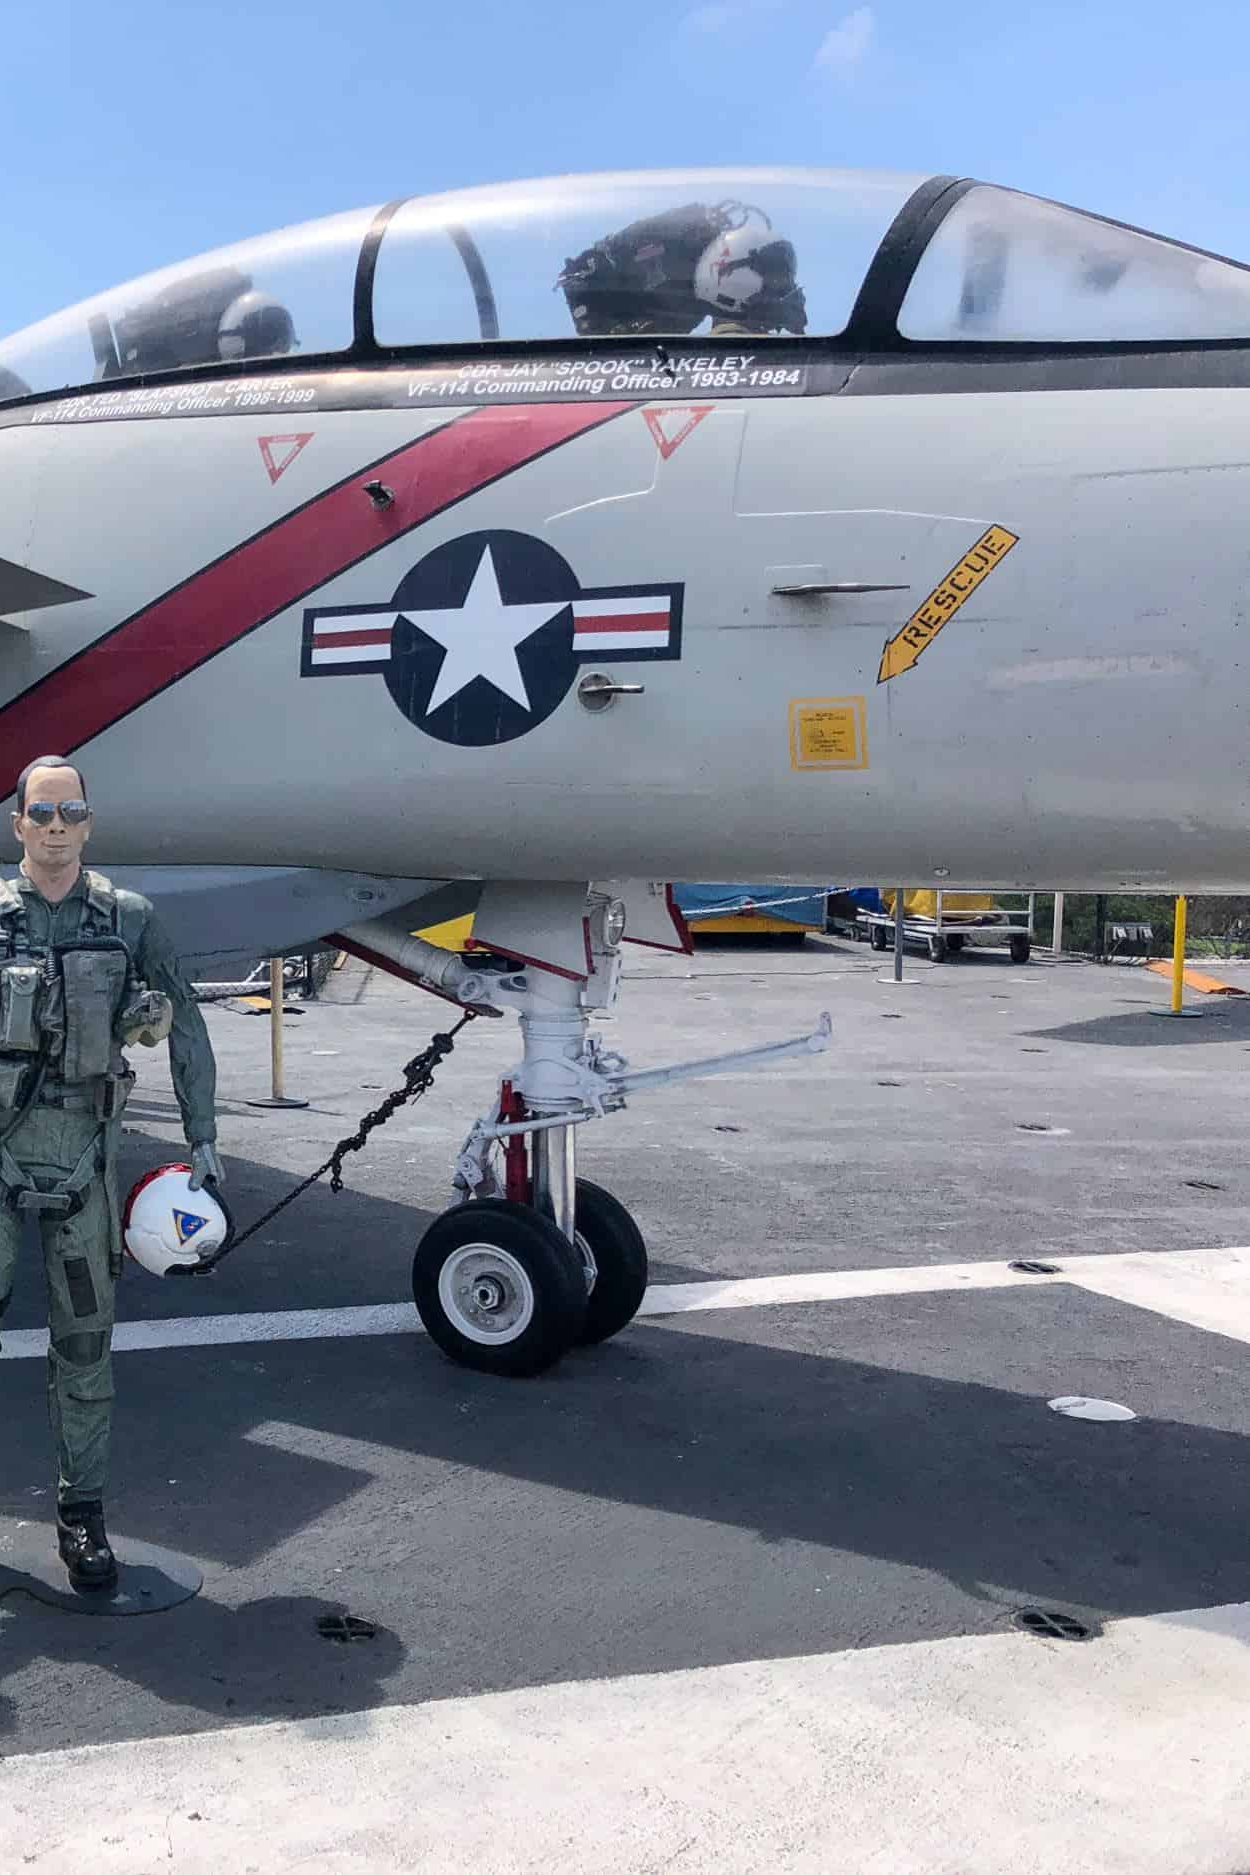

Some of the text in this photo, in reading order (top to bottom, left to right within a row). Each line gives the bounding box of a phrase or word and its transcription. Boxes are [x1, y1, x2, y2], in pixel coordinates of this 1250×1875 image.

[551, 359, 645, 376] "SPOOK"
[650, 355, 755, 373] YAKELEY
[407, 369, 799, 398] VF-114 Commanding Officer 1983-1984
[77, 399, 173, 418] Commanding
[177, 395, 230, 410] Officer
[902, 535, 1006, 648] RESCUE
